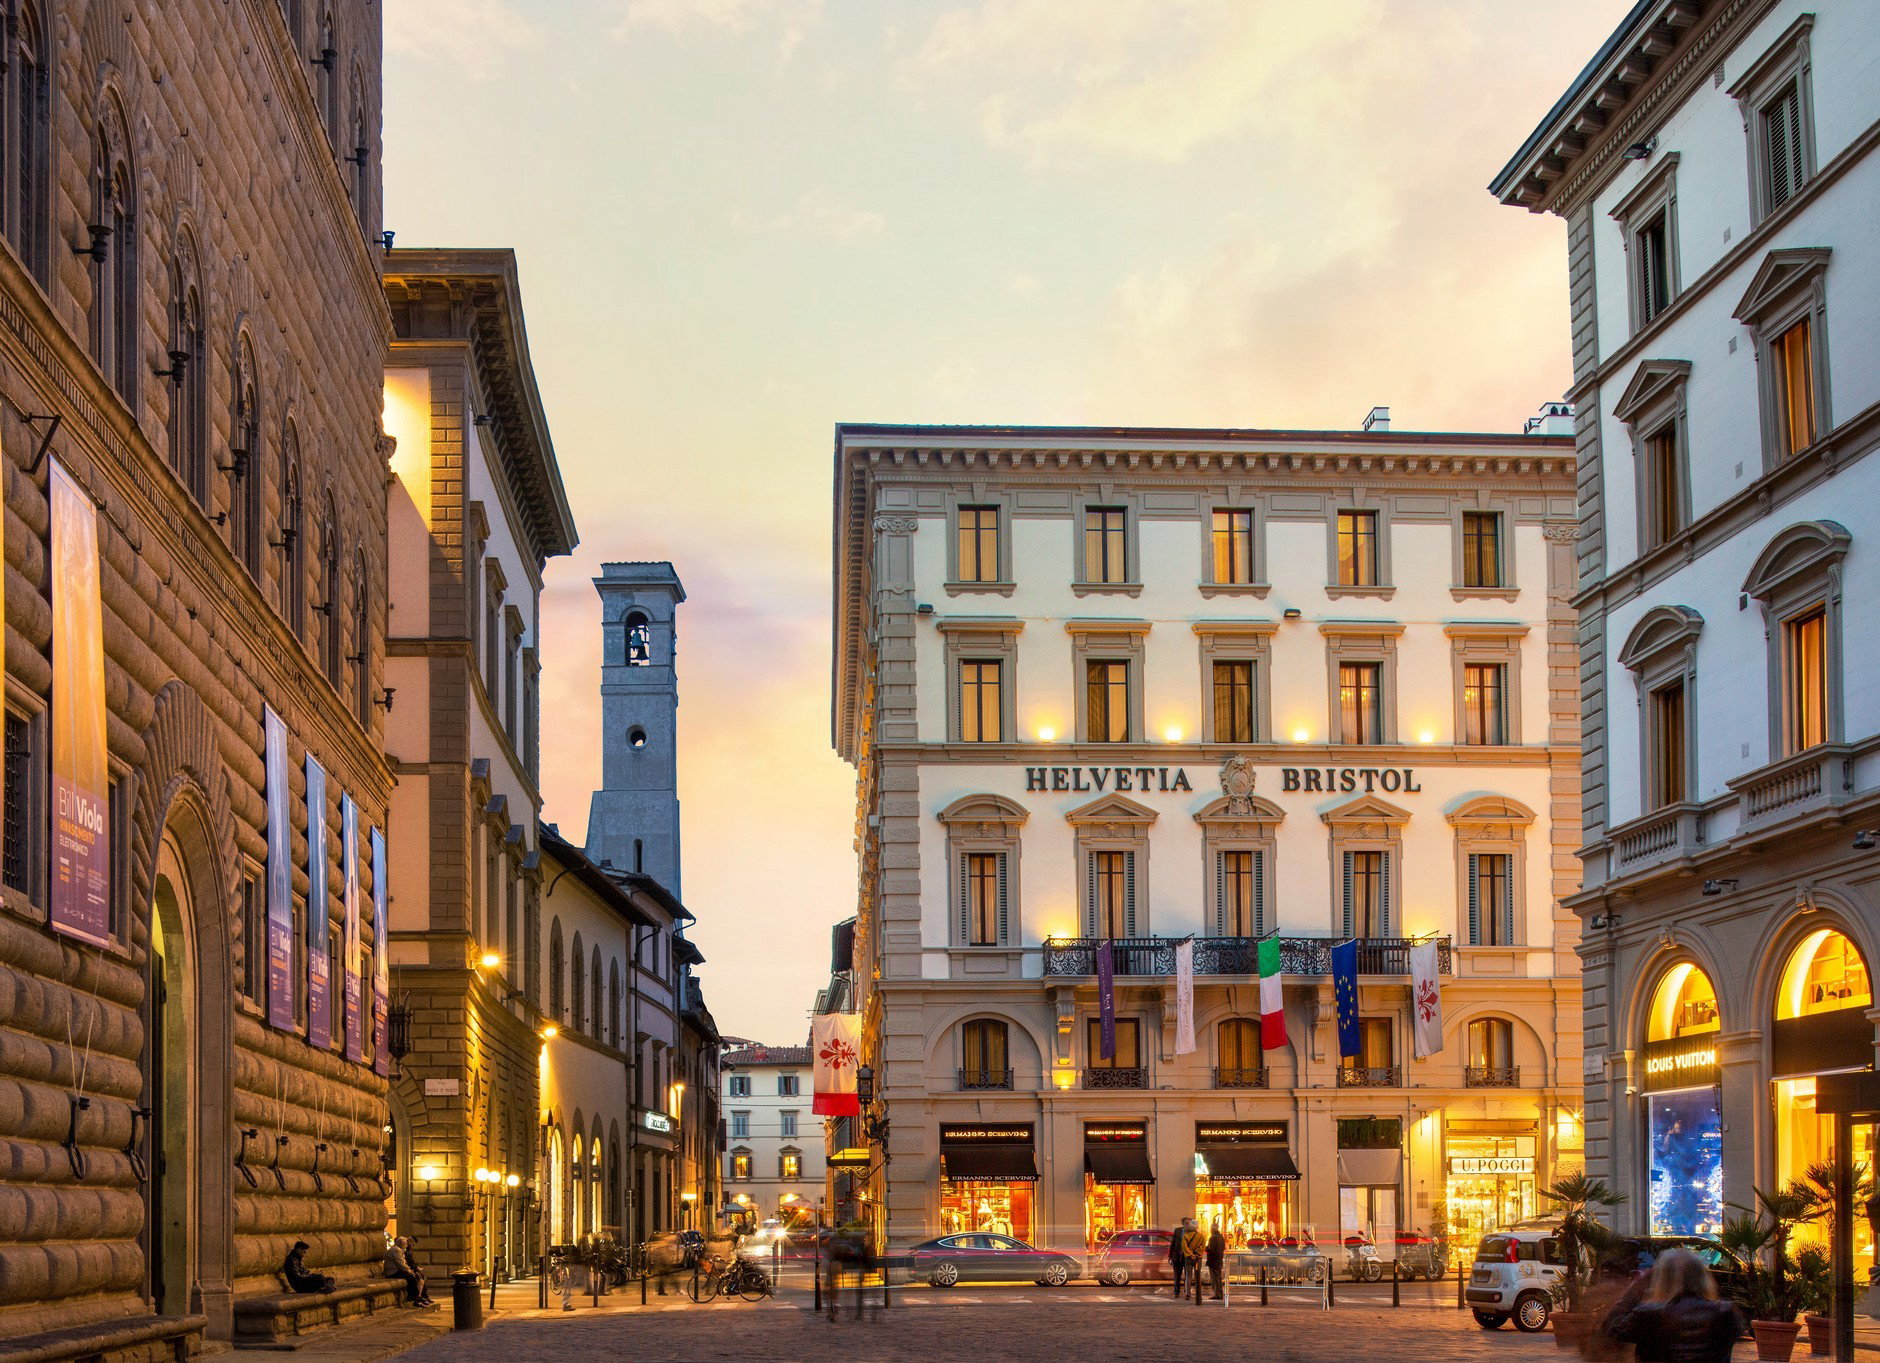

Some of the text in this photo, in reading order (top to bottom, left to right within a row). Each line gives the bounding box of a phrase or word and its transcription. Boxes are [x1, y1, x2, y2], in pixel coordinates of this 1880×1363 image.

[1025, 767, 1421, 792] HELVETIA BRISTOL
[59, 786, 103, 835] Bill Viola
[1647, 1050, 1716, 1073] LOUIS VUITTON
[1462, 1160, 1525, 1172] U. POGGI
